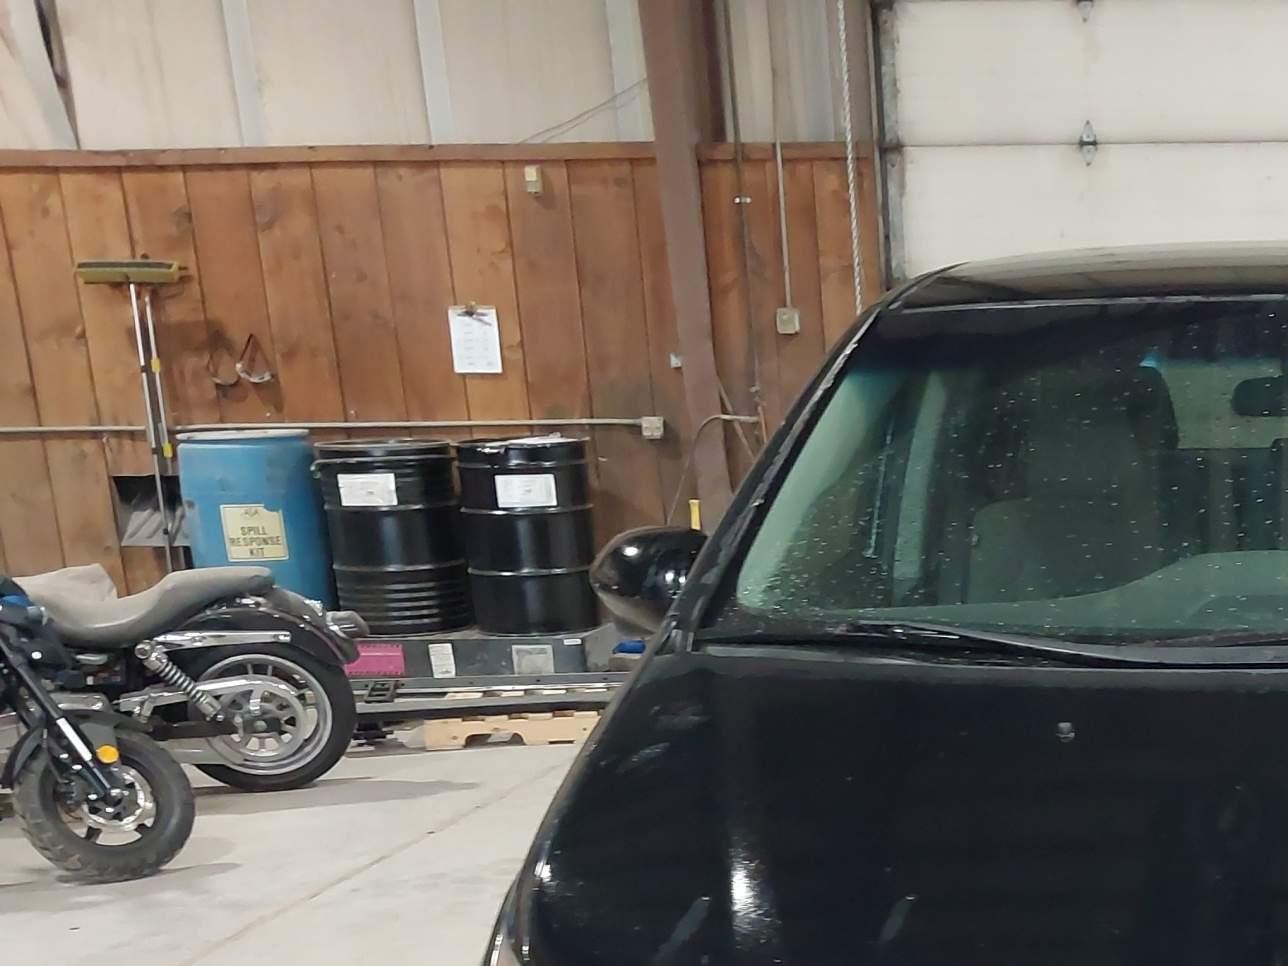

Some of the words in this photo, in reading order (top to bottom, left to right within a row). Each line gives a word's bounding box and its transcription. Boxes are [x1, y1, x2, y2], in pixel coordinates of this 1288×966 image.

[240, 526, 267, 536] SPILL
[229, 535, 281, 547] RESPONSE
[249, 547, 265, 557] KIT
